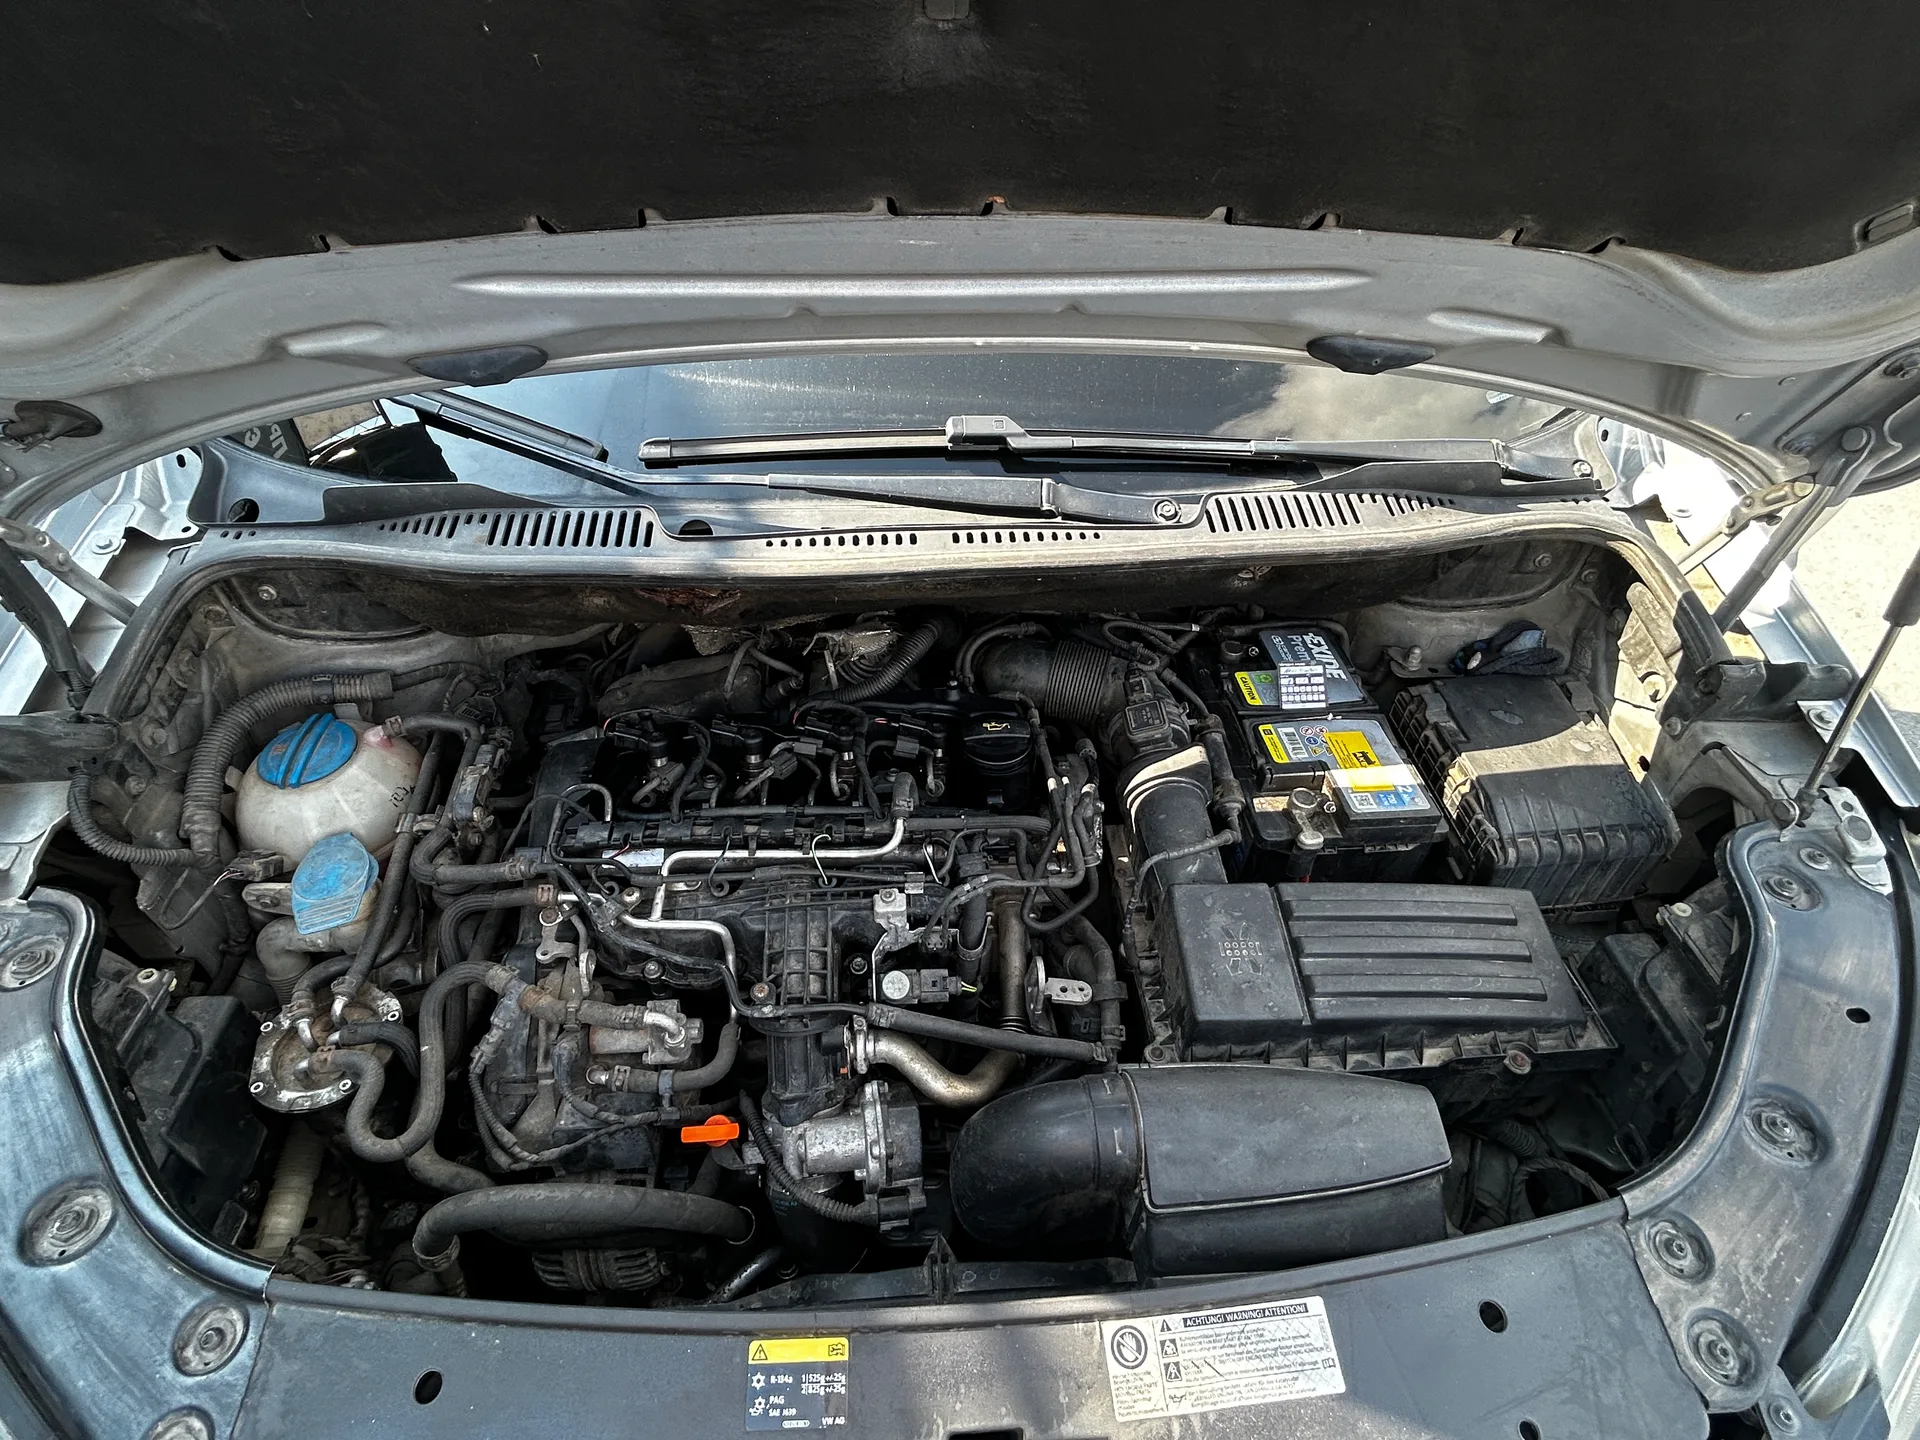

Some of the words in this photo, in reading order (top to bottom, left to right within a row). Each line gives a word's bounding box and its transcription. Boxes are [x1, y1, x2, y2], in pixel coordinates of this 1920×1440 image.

[1287, 635, 1311, 661] Prem
[1240, 677, 1257, 700] CAUTION
[1186, 1314, 1225, 1327] ACHTUNG!
[1225, 1309, 1264, 1322] WARNING!
[1264, 1303, 1306, 1317] ATTENTION!
[770, 1374, 793, 1384] R-134a
[769, 1395, 785, 1405] PAG
[768, 1408, 780, 1417] SAE
[821, 1417, 834, 1426] VW
[834, 1416, 846, 1426] AG
